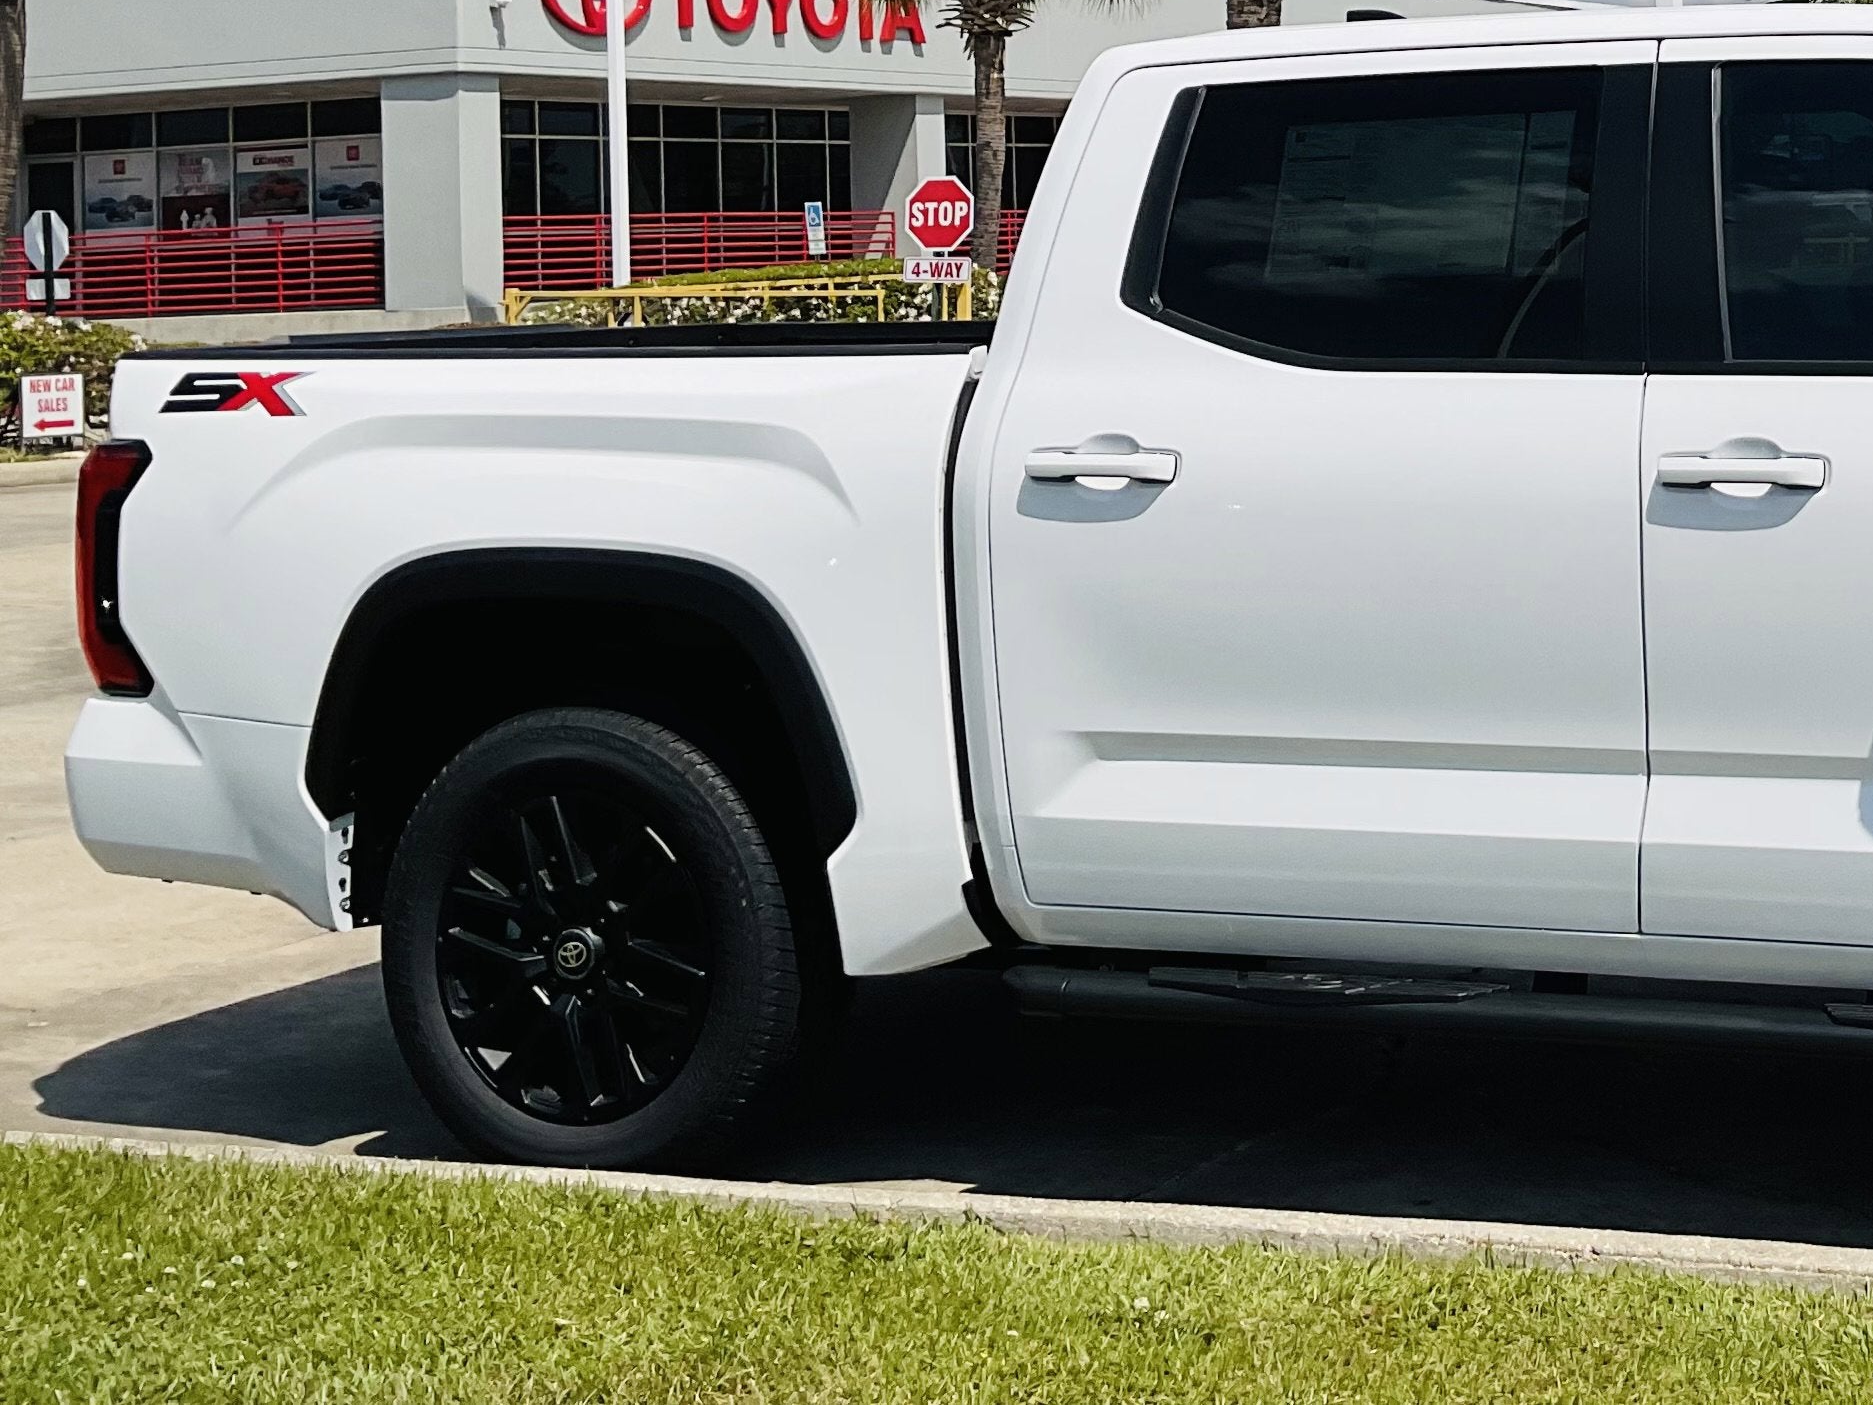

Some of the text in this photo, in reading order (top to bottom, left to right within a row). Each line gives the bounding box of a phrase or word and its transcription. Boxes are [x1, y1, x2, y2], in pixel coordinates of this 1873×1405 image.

[910, 201, 969, 227] STOP
[911, 261, 964, 279] 4-WAY
[29, 377, 76, 393] NEW CAR
[37, 397, 68, 413] SALES
